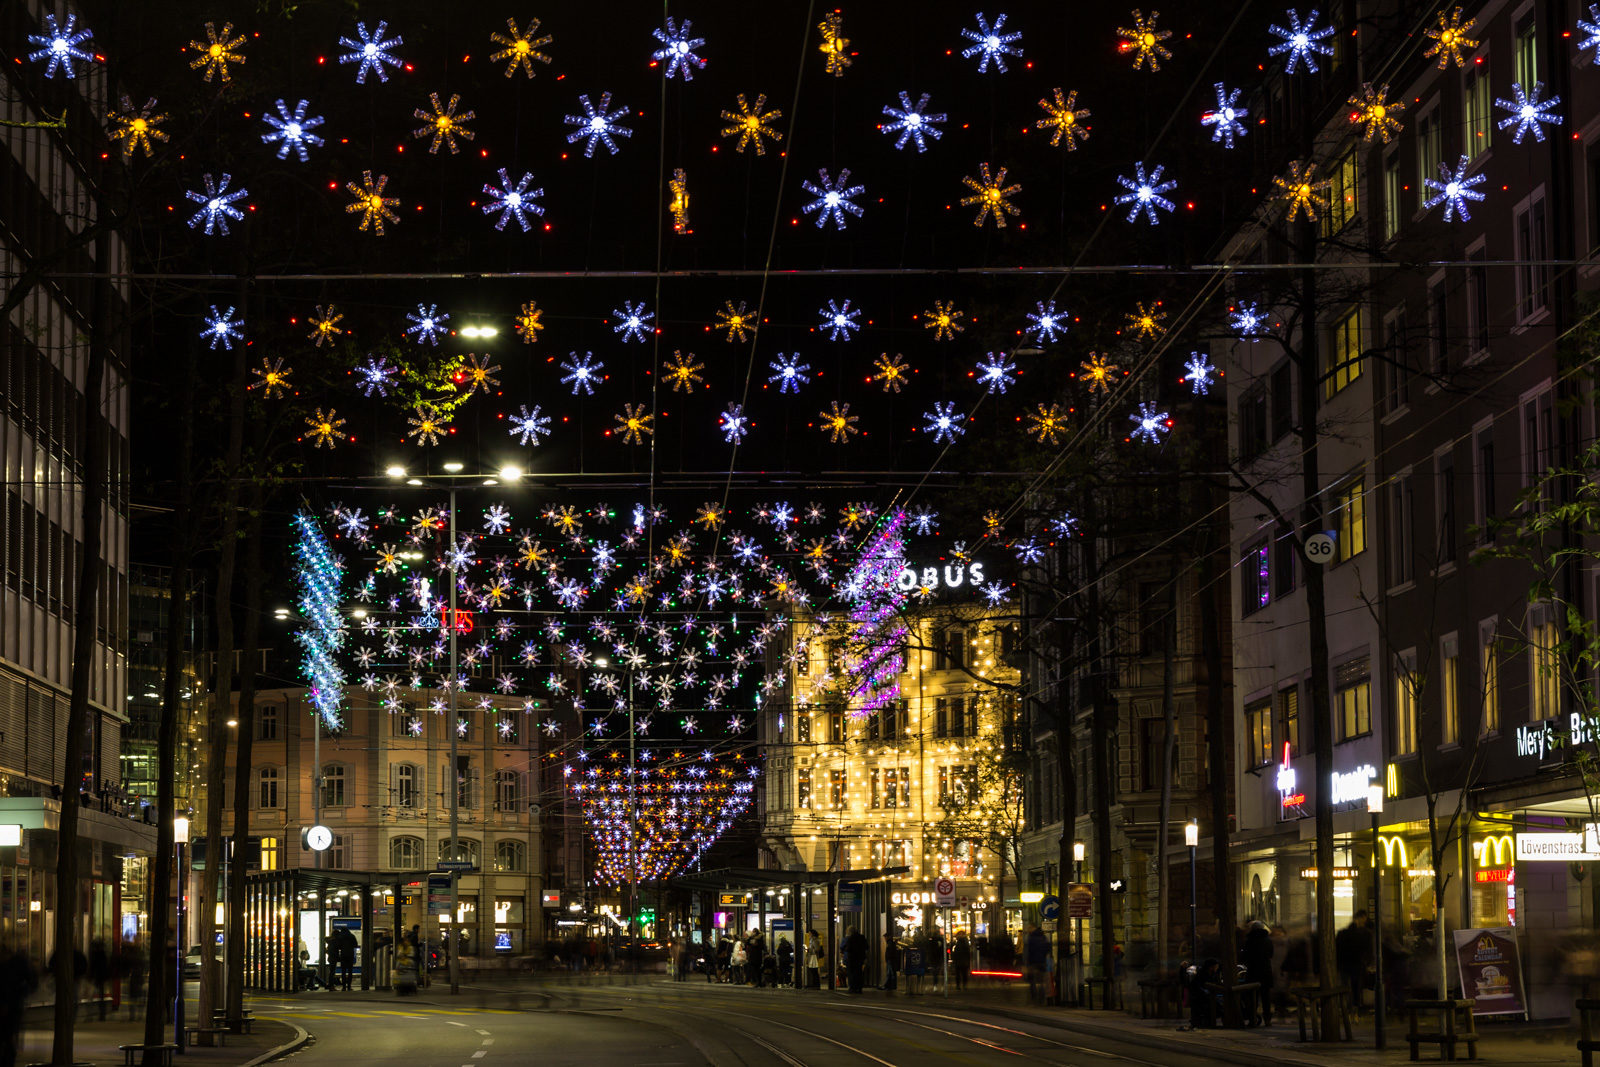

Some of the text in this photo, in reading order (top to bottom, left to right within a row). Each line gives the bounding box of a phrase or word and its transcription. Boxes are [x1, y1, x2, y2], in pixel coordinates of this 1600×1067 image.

[1309, 541, 1331, 555] 36
[897, 562, 984, 591] OBUS
[1517, 720, 1554, 760] Mery's
[1521, 839, 1583, 854] Löwenstras
